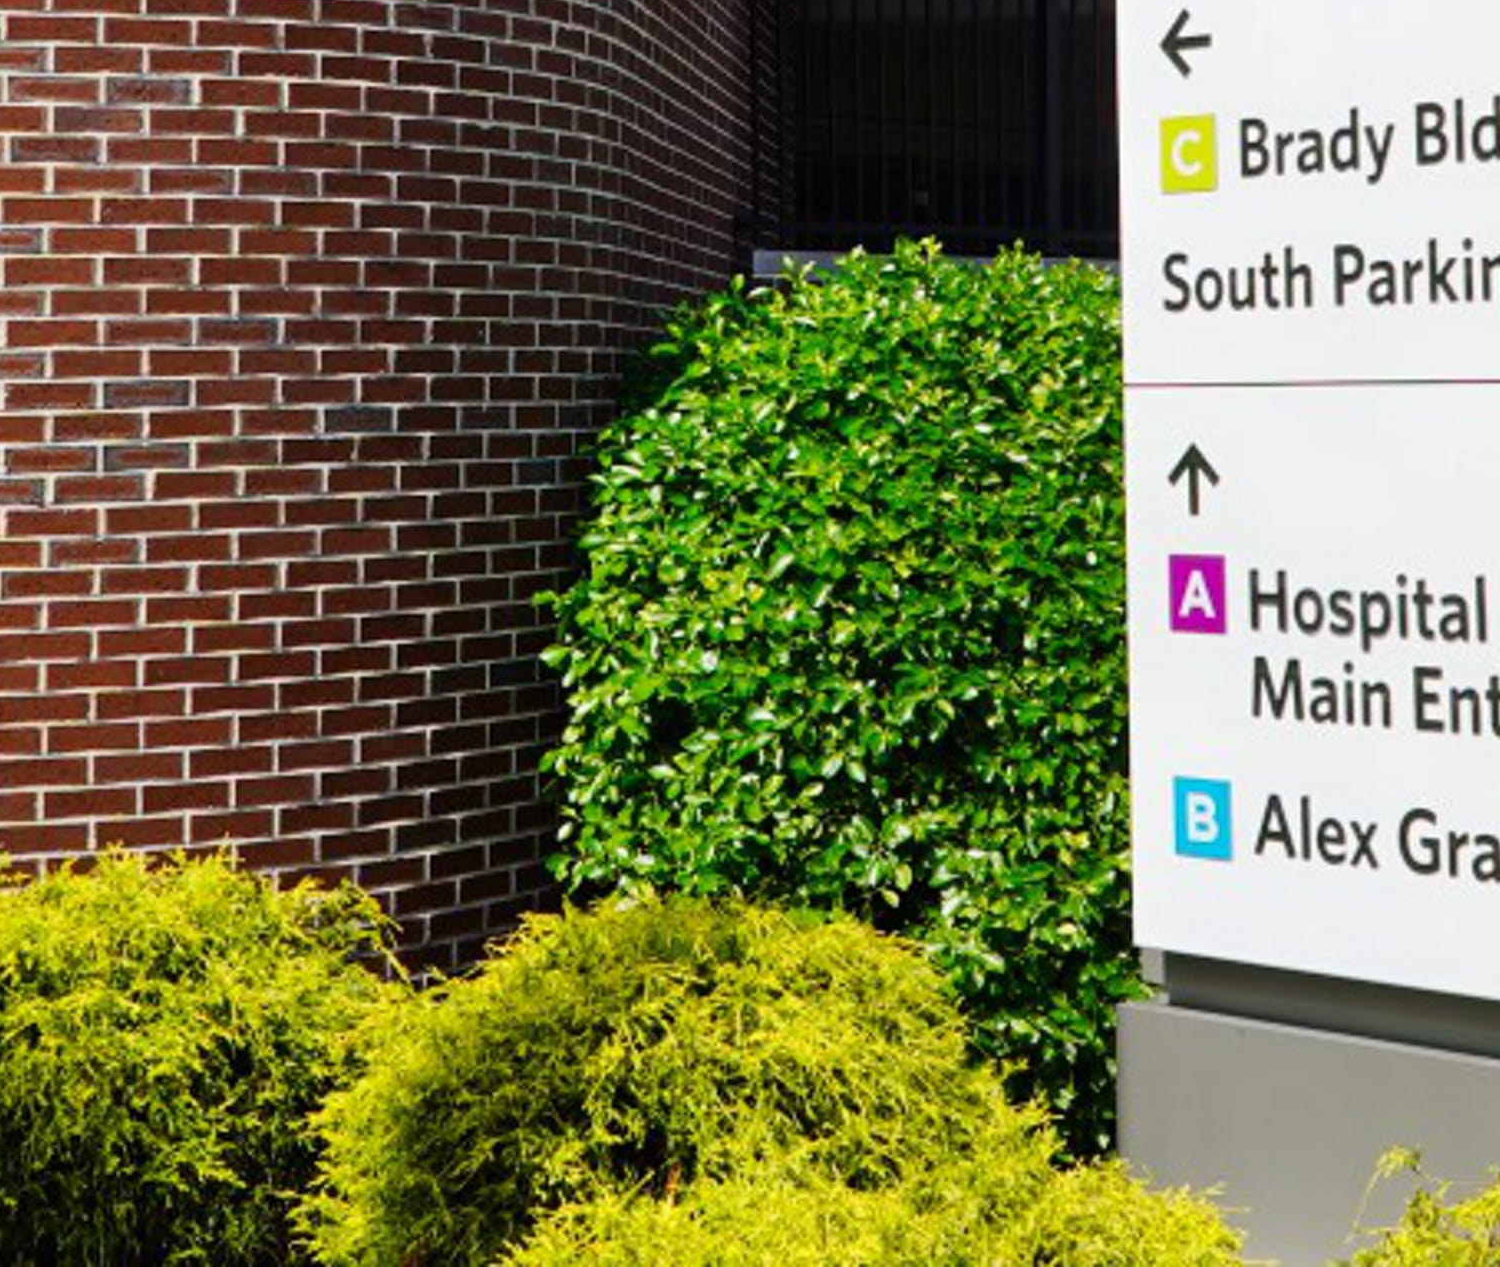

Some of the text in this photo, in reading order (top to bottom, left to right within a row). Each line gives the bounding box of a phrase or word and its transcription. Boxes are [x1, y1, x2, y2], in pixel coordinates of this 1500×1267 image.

[1169, 128, 1204, 178] C
[1239, 106, 1396, 186] Brady
[1162, 245, 1314, 313] South
[1178, 567, 1488, 654] A Hospital
[1251, 655, 1392, 729] Main
[1185, 790, 1220, 844] B
[1253, 793, 1380, 870] Alex
